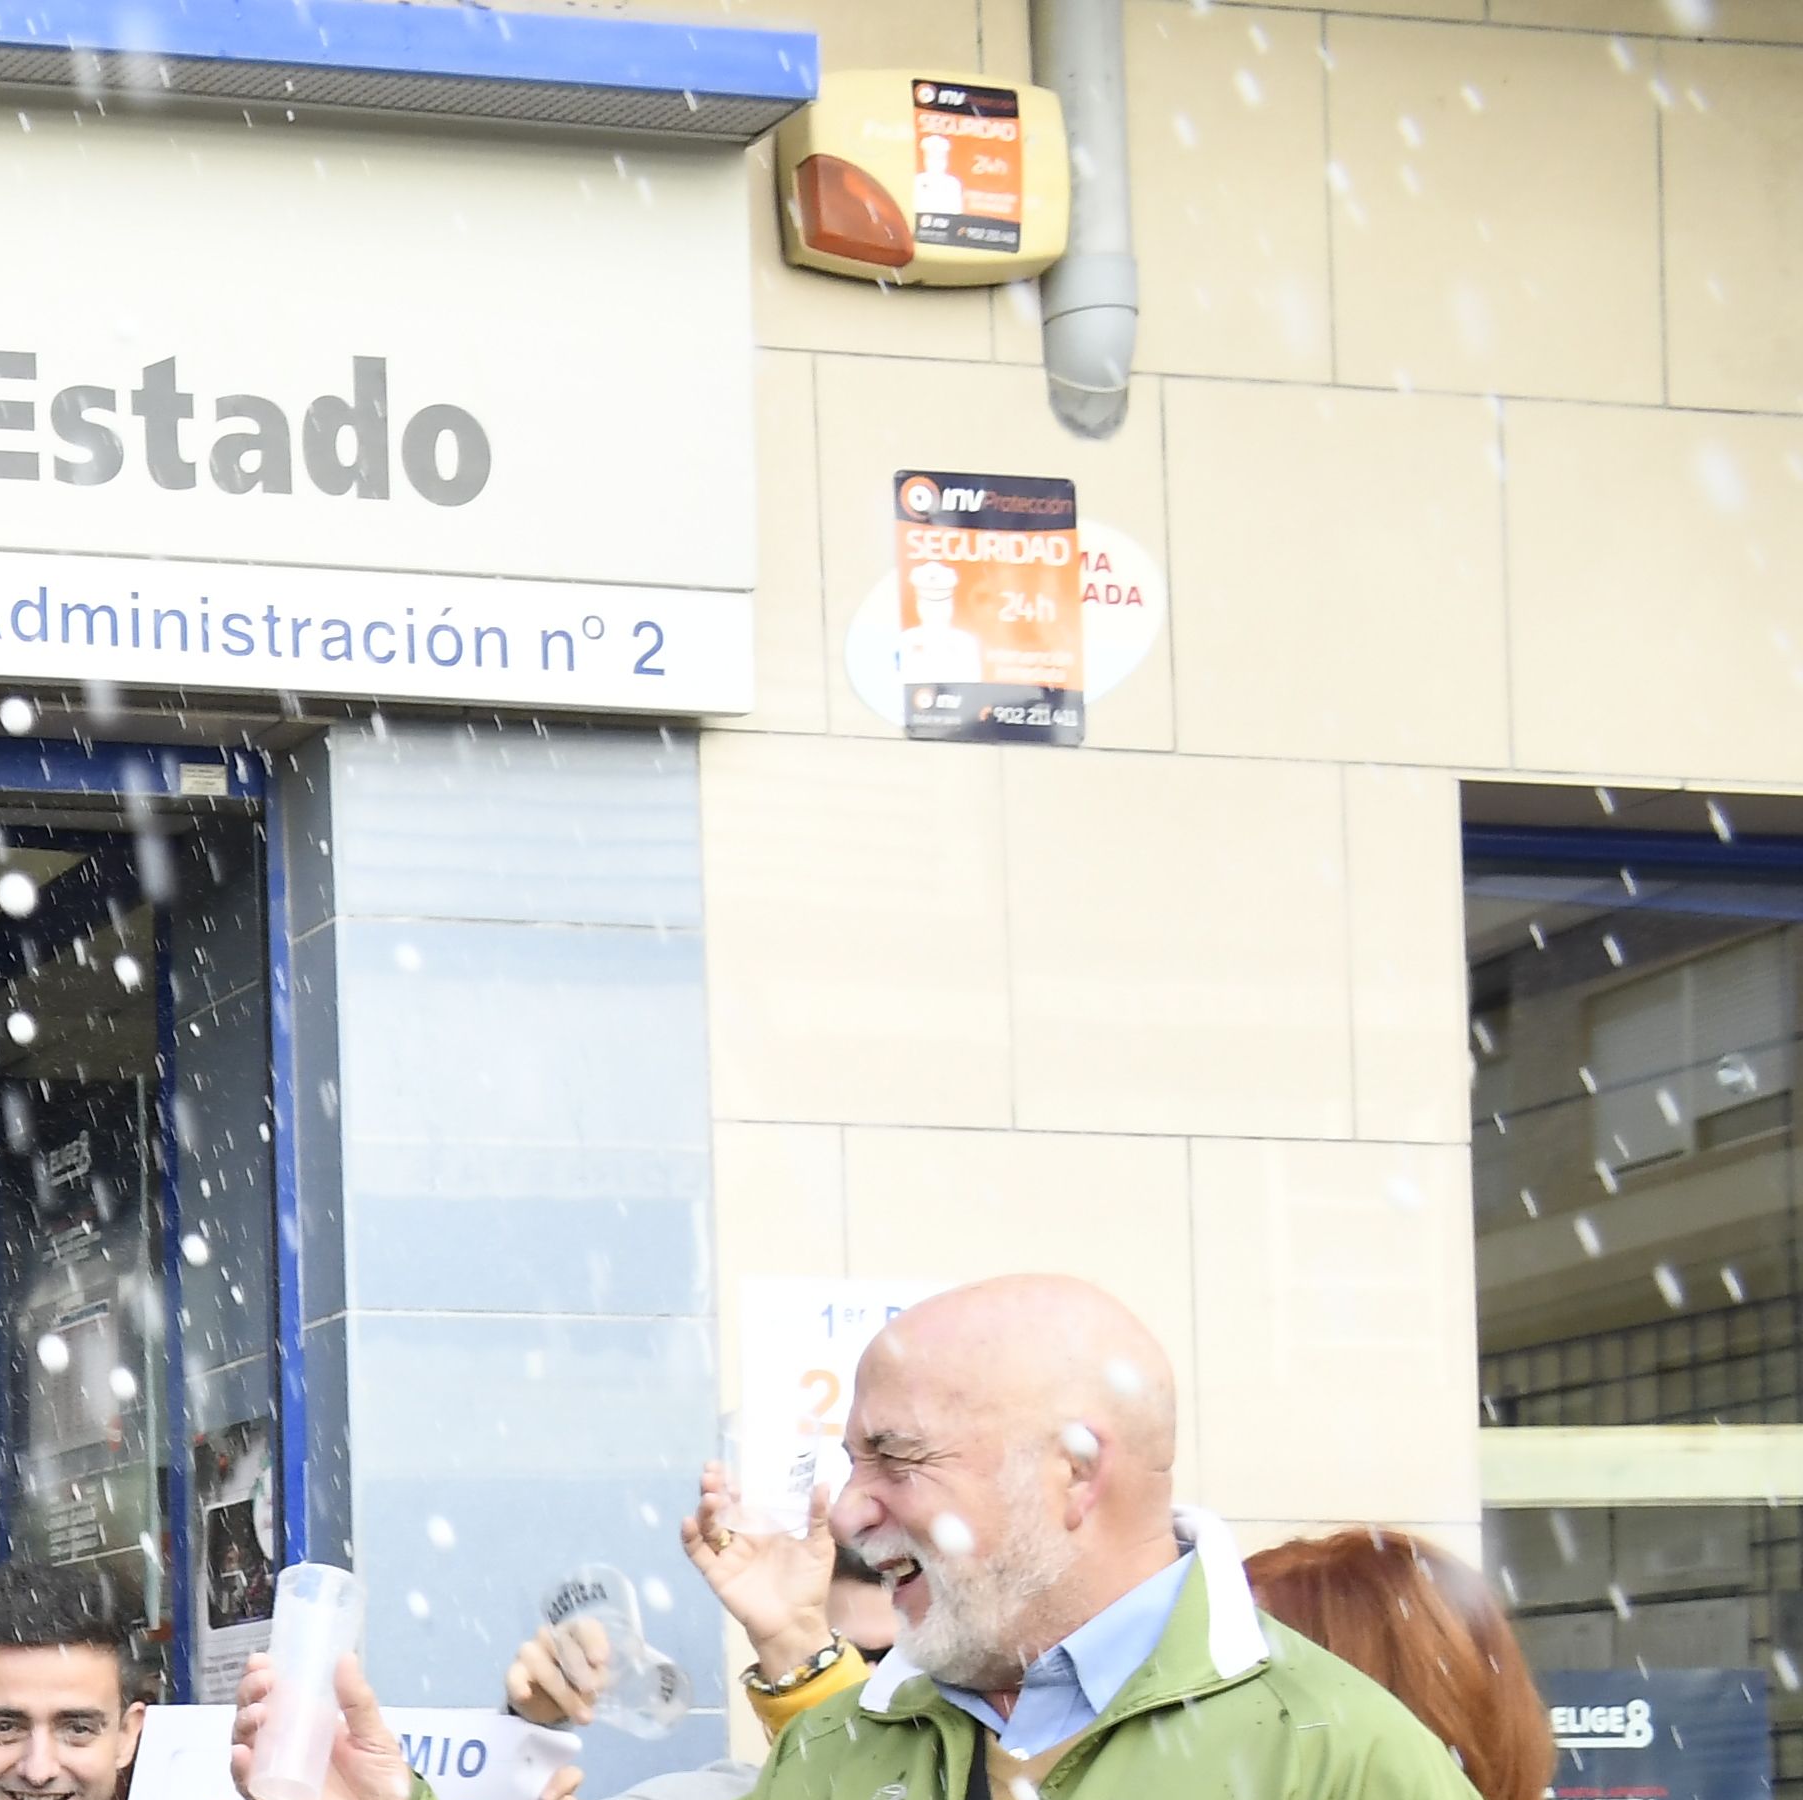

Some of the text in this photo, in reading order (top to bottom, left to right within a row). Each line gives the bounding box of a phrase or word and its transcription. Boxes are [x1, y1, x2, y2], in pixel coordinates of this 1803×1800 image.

[905, 530, 1071, 567] SEGURIDAD
[997, 591, 1056, 623] 24h
[631, 619, 667, 677] 2
